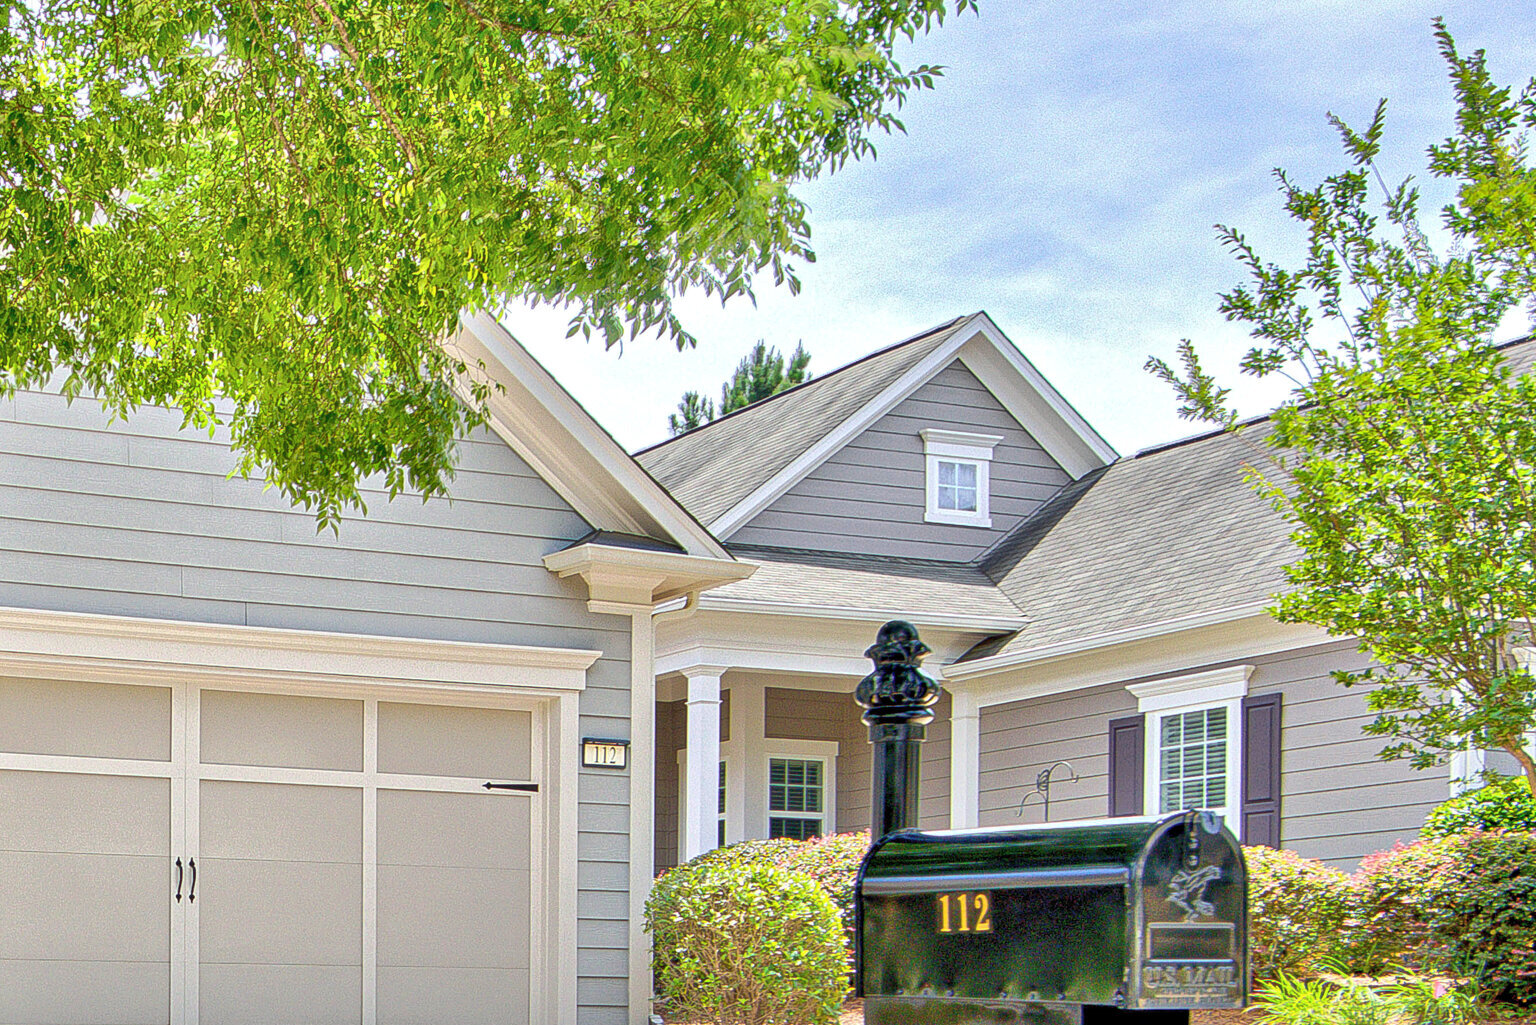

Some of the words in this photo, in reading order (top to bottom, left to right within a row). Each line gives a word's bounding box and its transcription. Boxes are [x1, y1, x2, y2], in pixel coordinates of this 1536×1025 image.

[594, 746, 617, 764] 112
[939, 893, 990, 932] 112
[1182, 966, 1237, 988] MAIL
